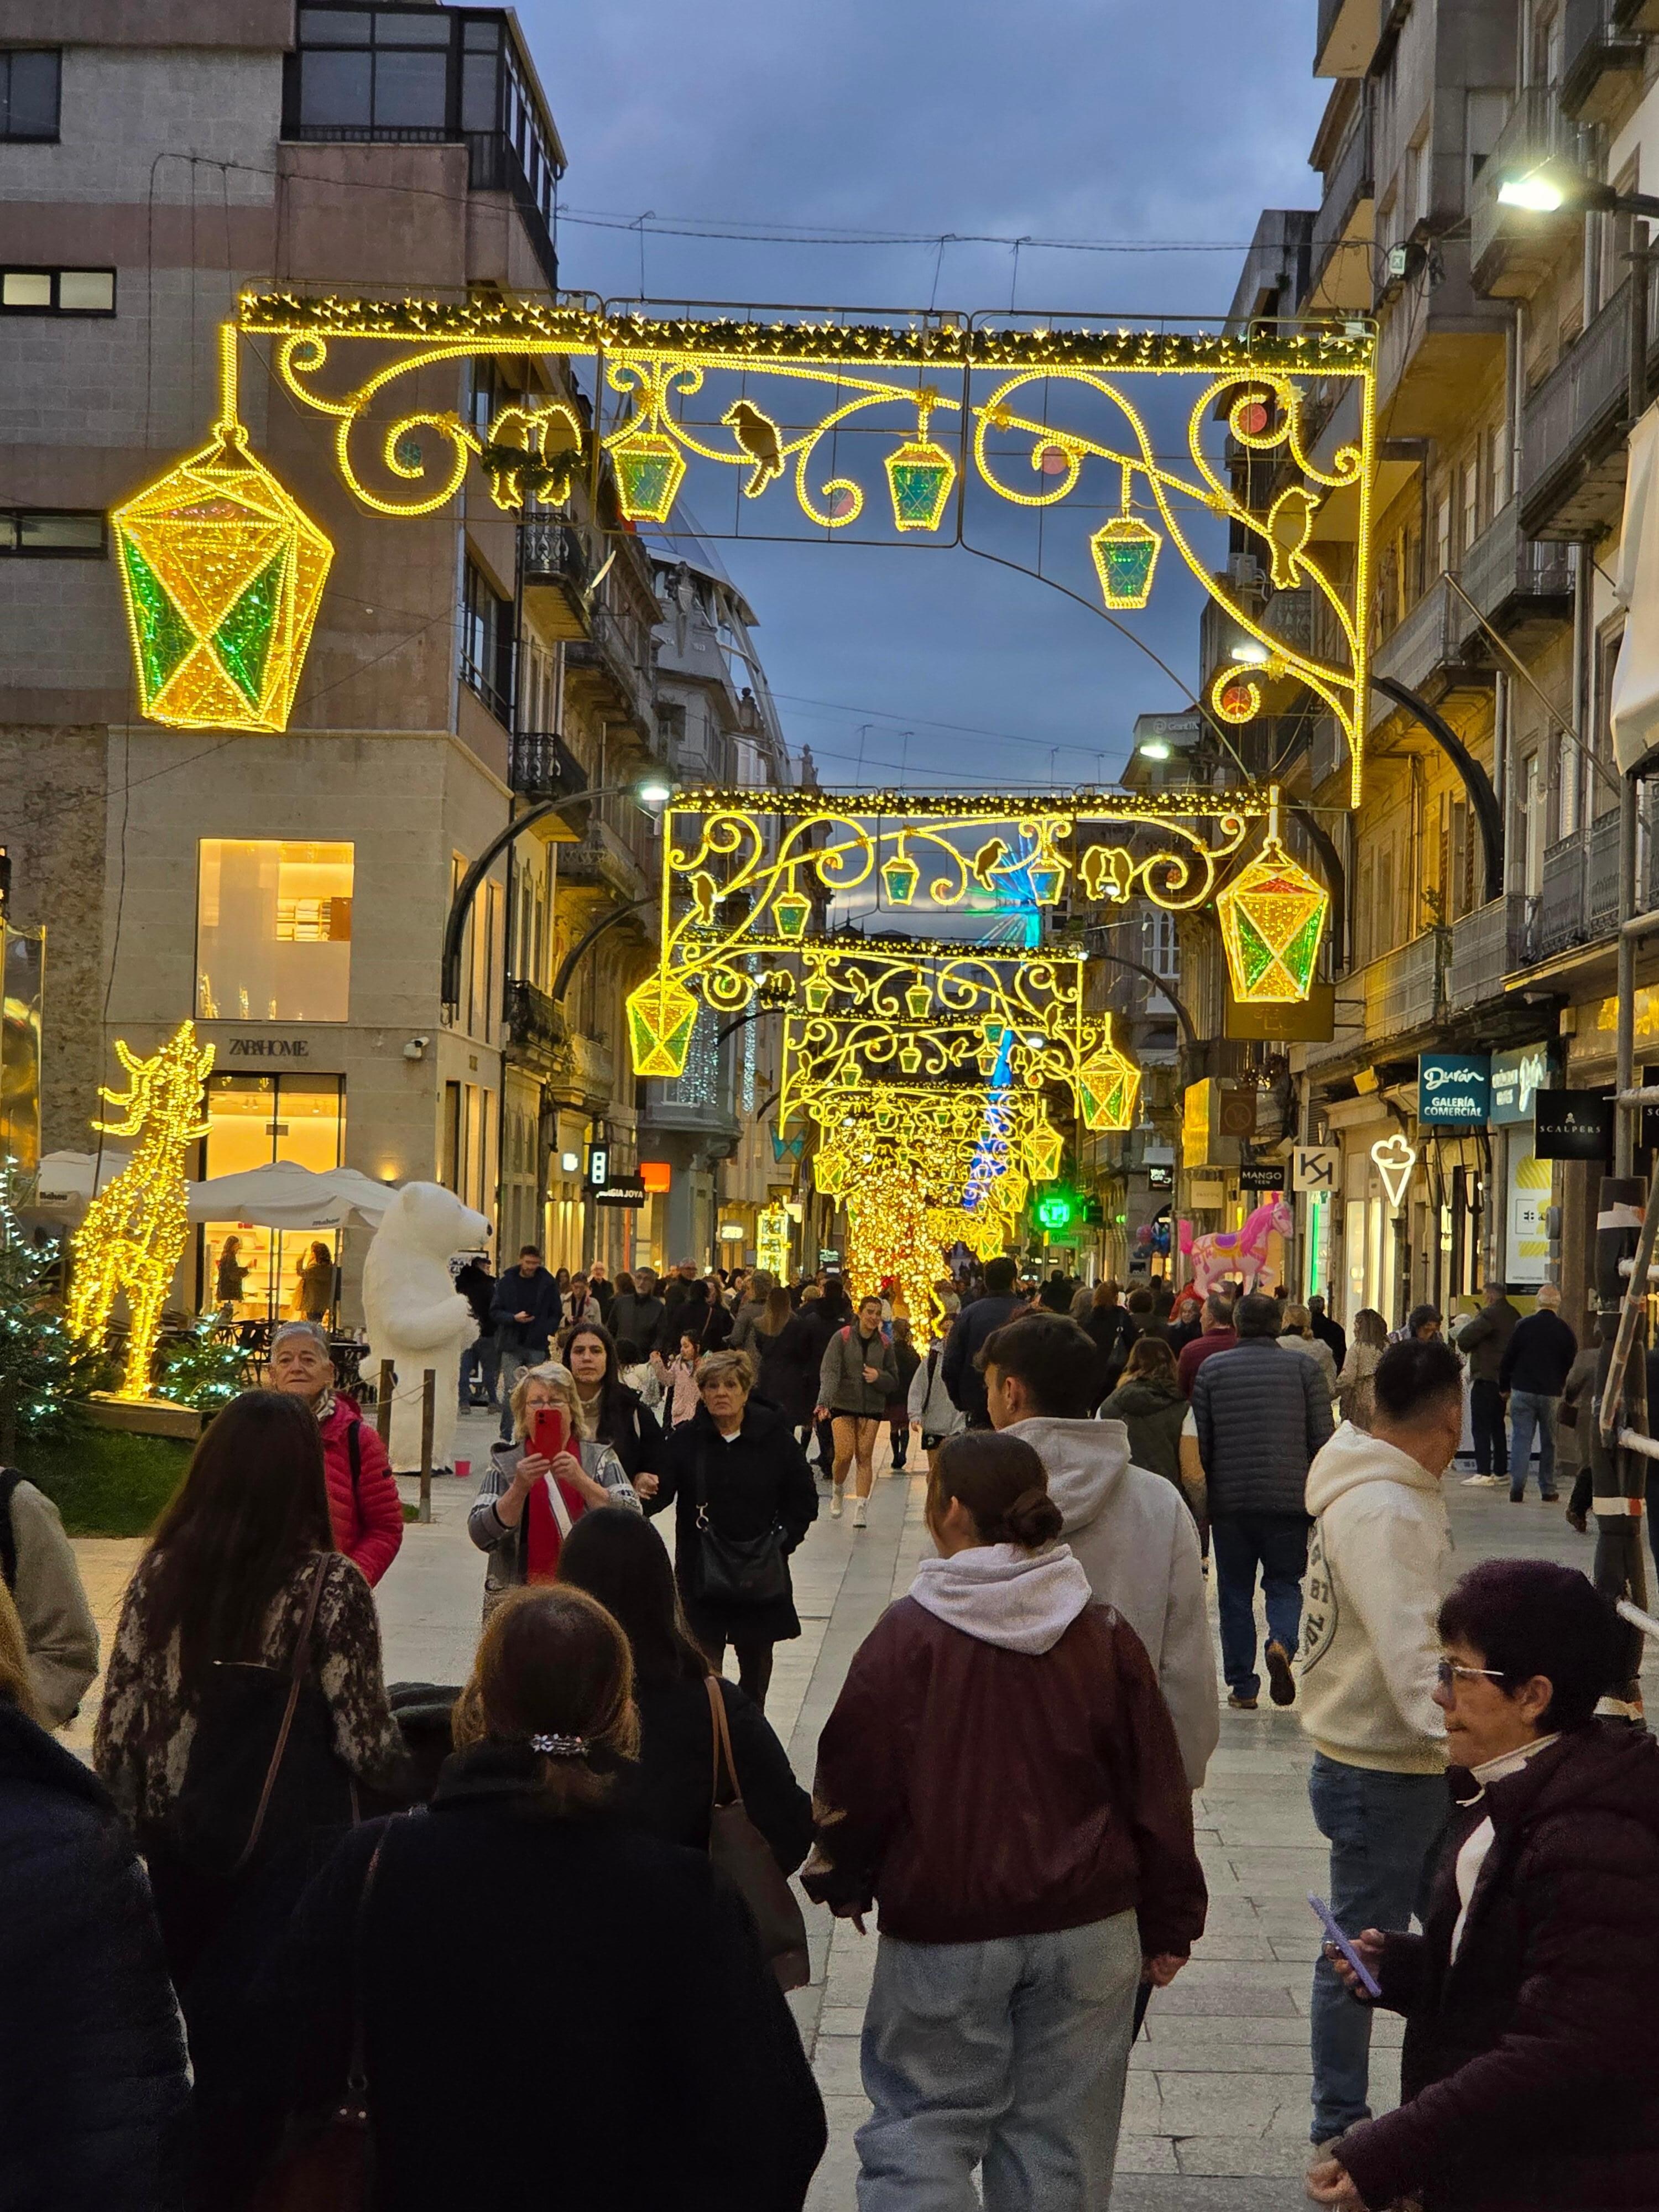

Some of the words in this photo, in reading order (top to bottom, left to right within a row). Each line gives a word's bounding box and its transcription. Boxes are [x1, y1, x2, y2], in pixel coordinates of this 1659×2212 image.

[1424, 1067, 1484, 1091] Durán
[1432, 1096, 1475, 1107] GALERÍA
[1424, 1107, 1483, 1117] COMERCIAL
[1242, 1172, 1282, 1180] MANGO
[624, 1190, 643, 1198] JOYA
